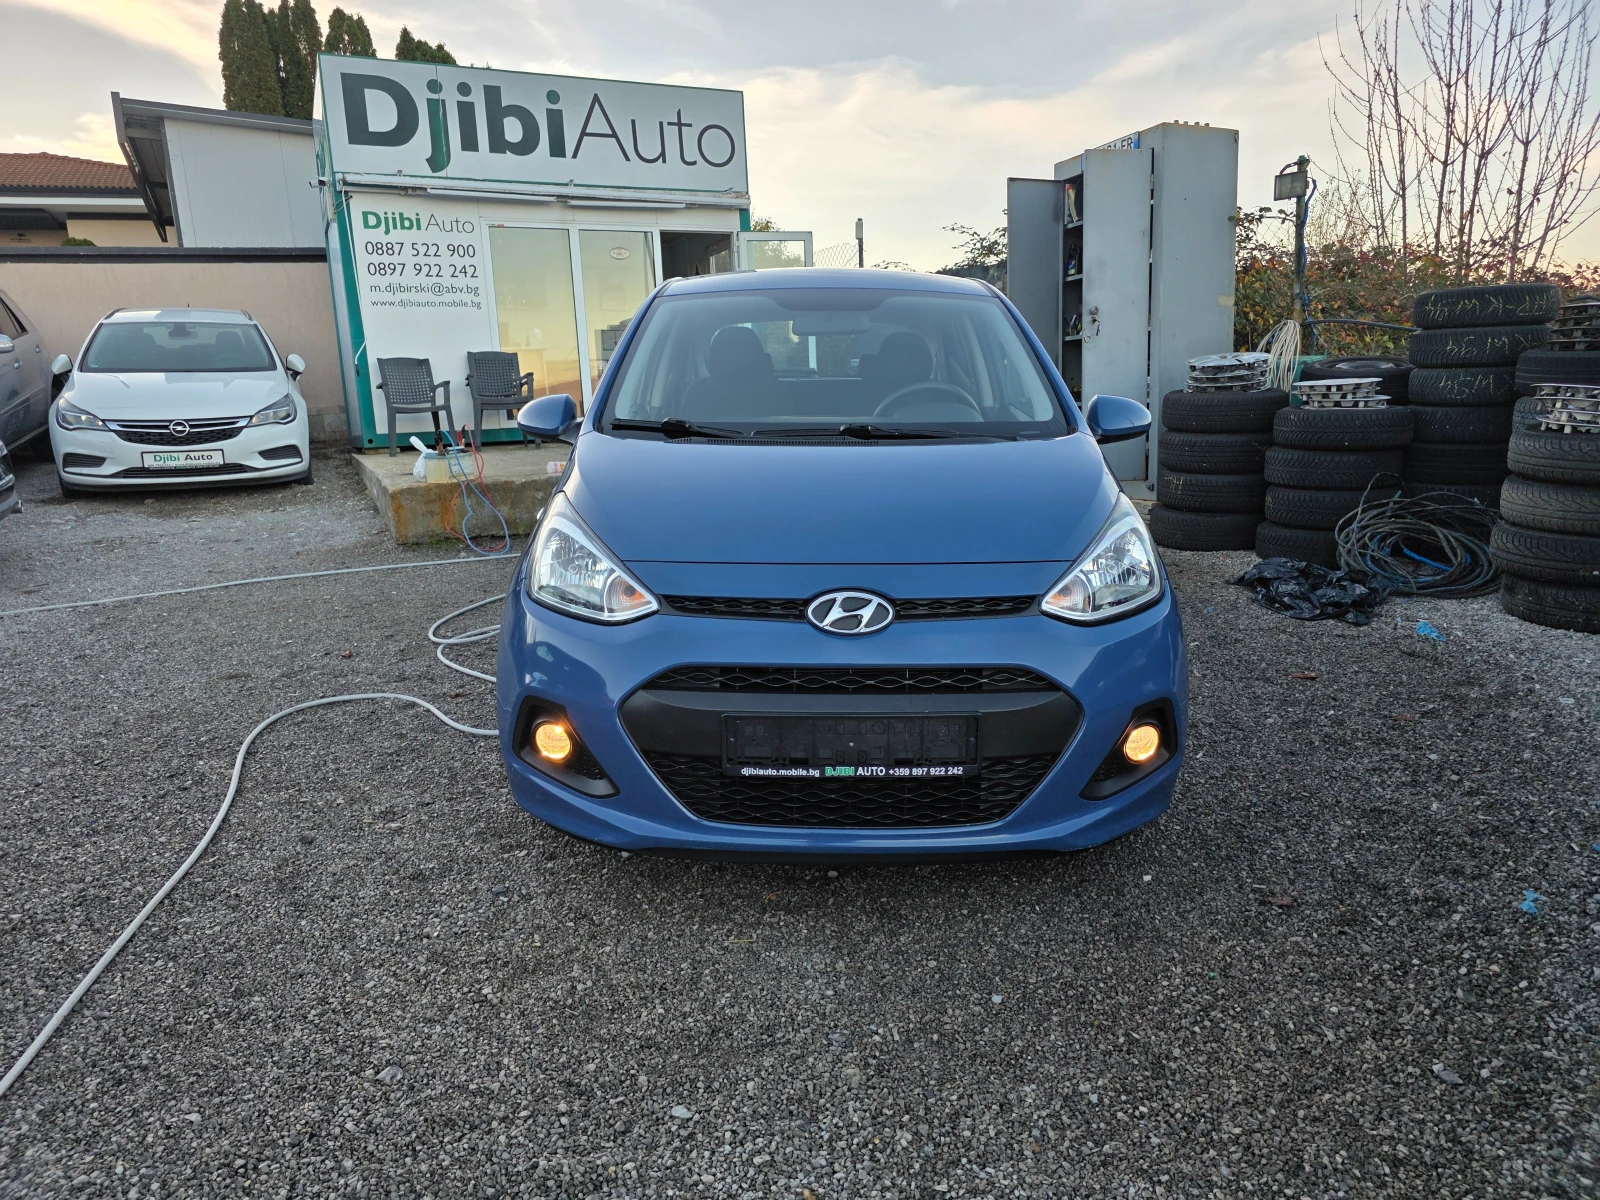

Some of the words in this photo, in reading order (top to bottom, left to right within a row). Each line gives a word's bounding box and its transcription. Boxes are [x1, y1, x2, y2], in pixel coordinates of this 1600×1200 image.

[340, 72, 566, 173] Djibi
[571, 92, 736, 167] Auto
[361, 211, 422, 235] Djibi
[425, 213, 475, 233] Auto
[365, 241, 404, 256] 0887
[411, 243, 441, 257] 522
[446, 244, 476, 258] 900
[367, 262, 406, 276] 0897
[413, 263, 443, 277] 922
[448, 264, 479, 278] 242
[370, 282, 480, 297] m.djibirski@abv.bg
[370, 299, 482, 310] www.djibiauto.mobile.bg
[153, 453, 180, 463] Djibi
[184, 453, 213, 461] Auto
[740, 767, 820, 777] djibiauto.mobile.bg
[825, 766, 855, 776] DJIBI
[856, 766, 886, 776] AUTO
[888, 767, 910, 776] +359
[912, 767, 928, 776] 897
[929, 766, 945, 776] 922
[947, 766, 963, 775] 242
